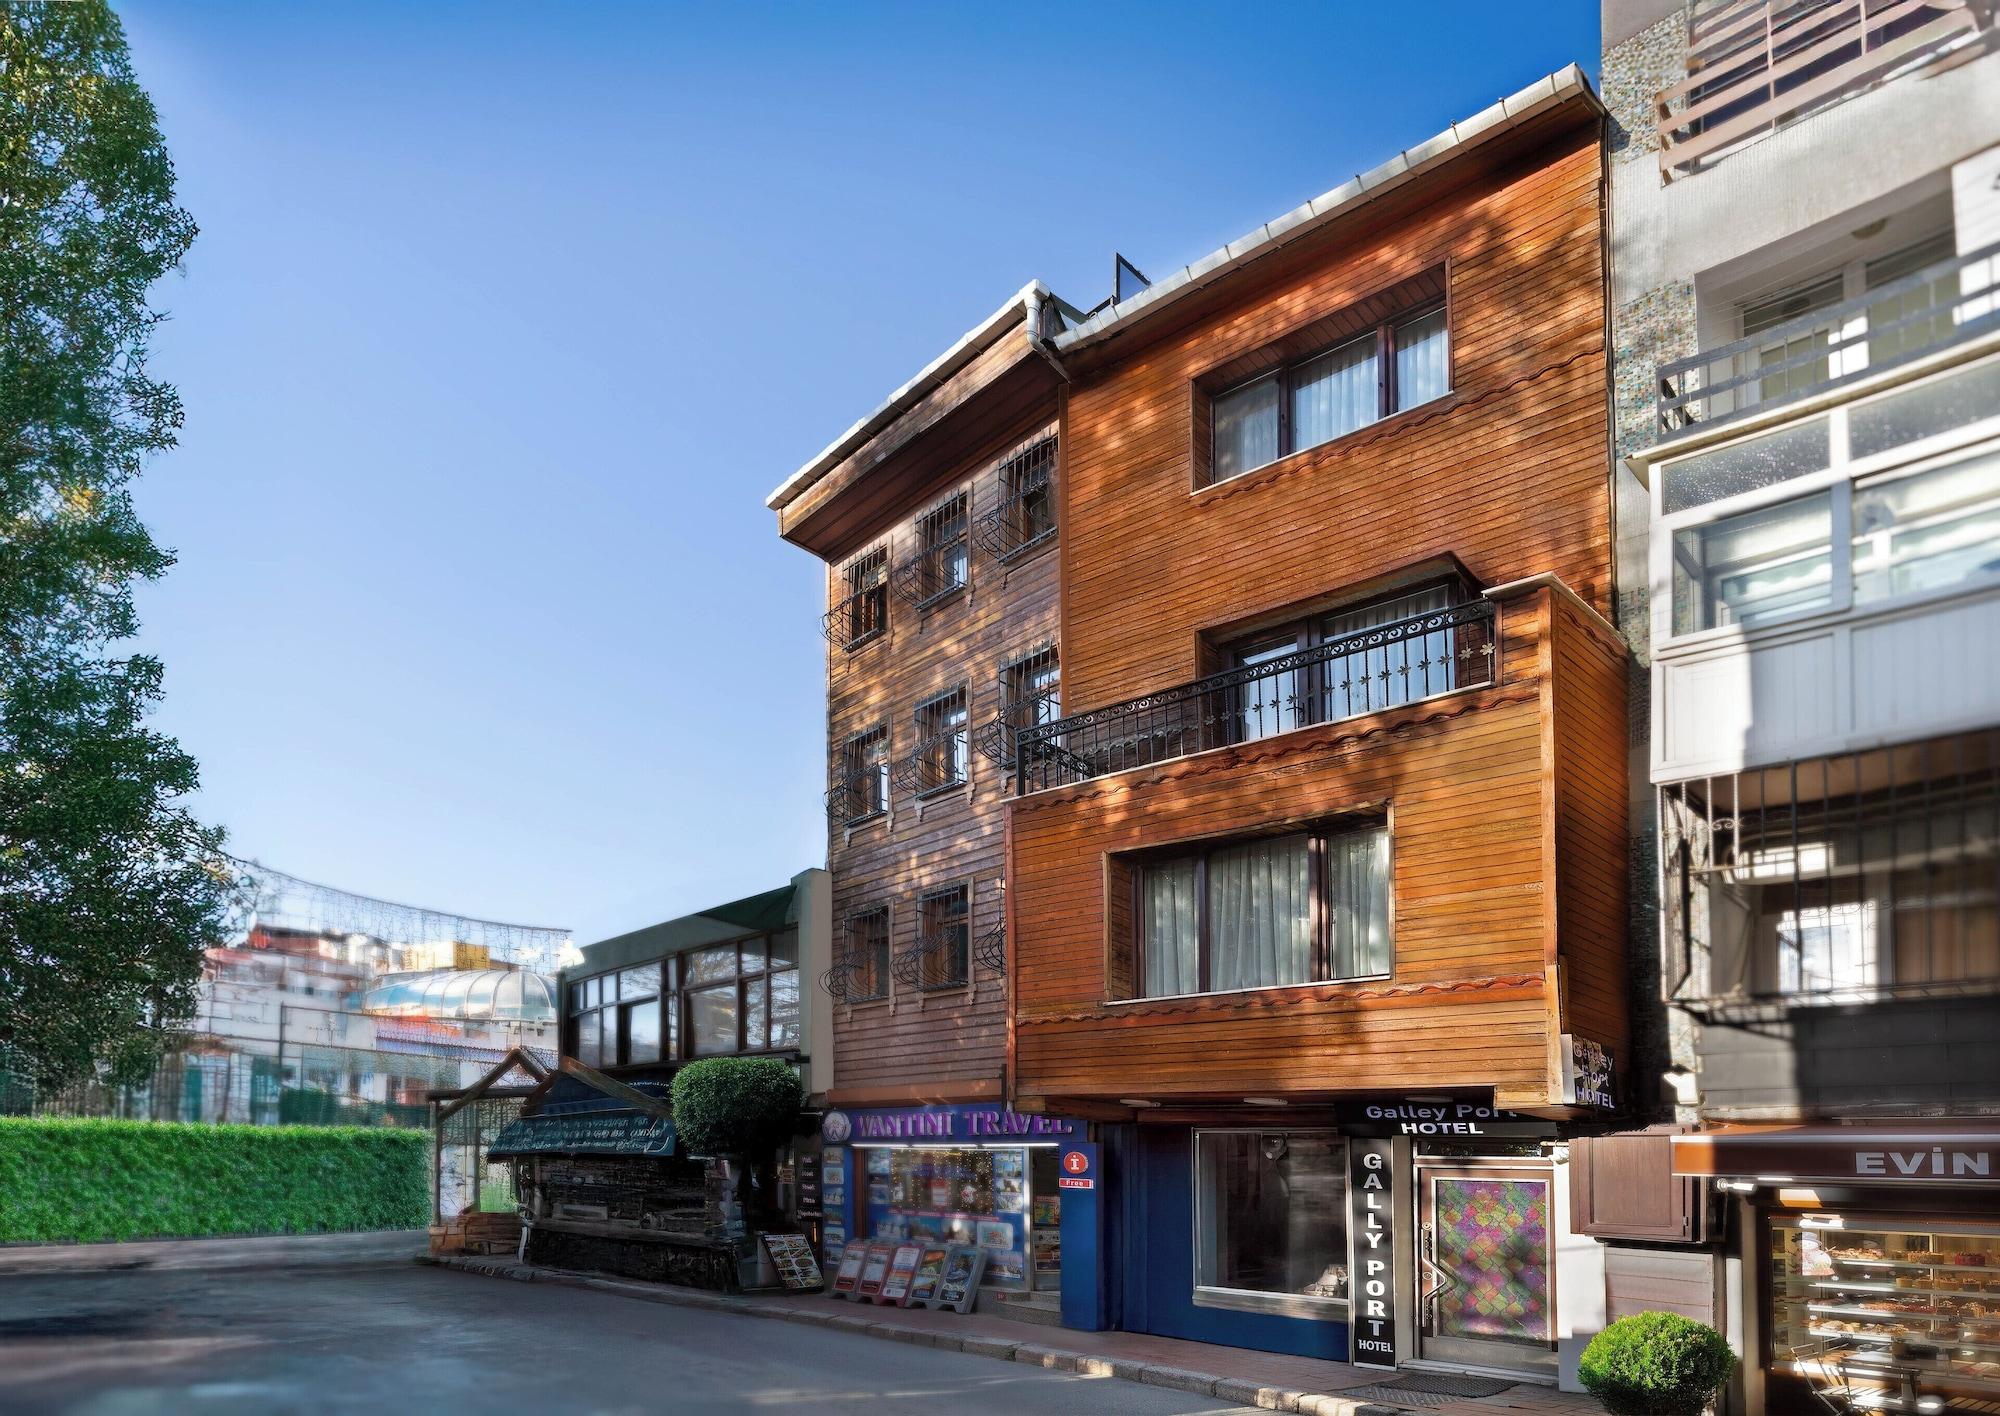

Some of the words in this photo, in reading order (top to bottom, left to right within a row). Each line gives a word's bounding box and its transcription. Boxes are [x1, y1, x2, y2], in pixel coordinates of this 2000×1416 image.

[1576, 1086, 1615, 1108] HOTEL
[1366, 1104, 1446, 1121] Galley
[1401, 1122, 1484, 1134] HOTEL
[1363, 1153, 1383, 1249] GALLY
[1366, 1260, 1386, 1337] PORT
[1358, 1339, 1393, 1353] HOTEL
